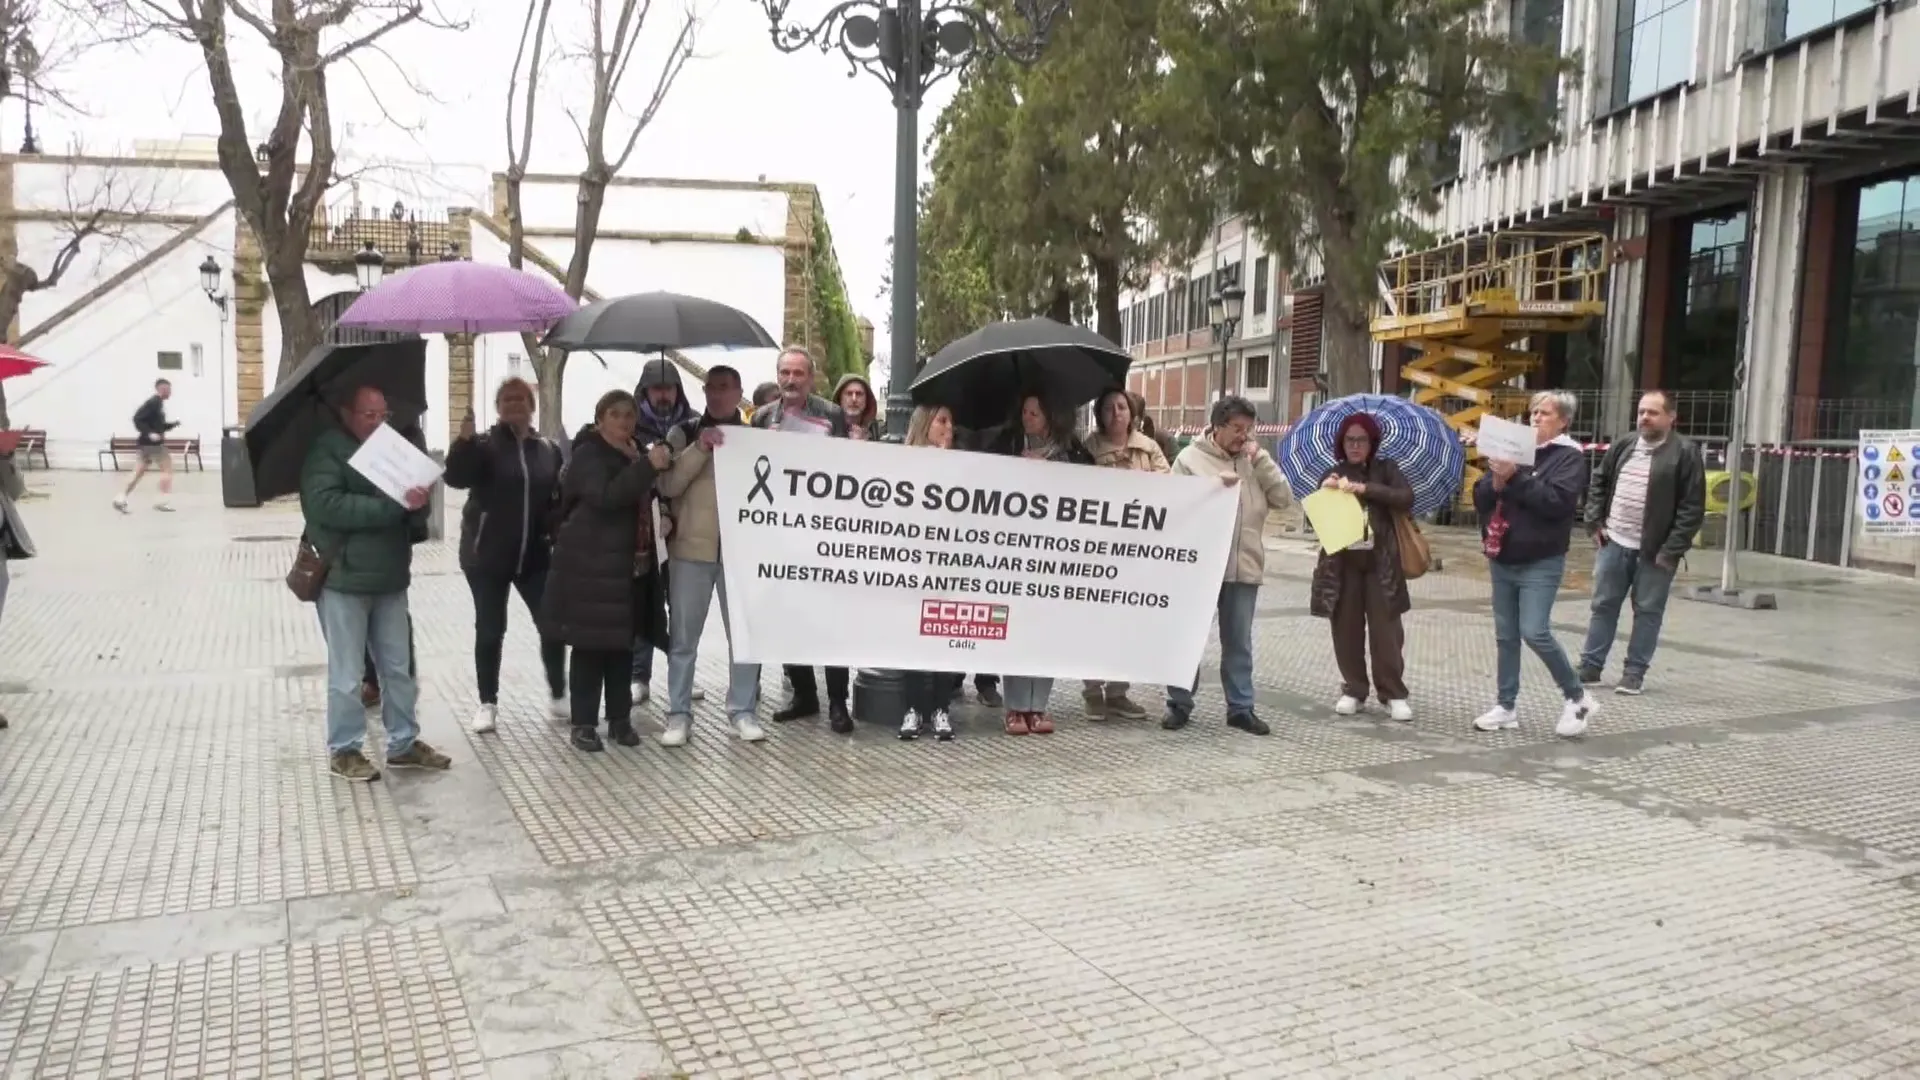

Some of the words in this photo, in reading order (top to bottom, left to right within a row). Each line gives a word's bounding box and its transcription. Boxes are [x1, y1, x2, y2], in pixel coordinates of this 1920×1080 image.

[783, 468, 915, 508] TOD@S
[921, 483, 1049, 520] SOMOS
[1055, 497, 1168, 531] BELÉN
[738, 508, 778, 526] POR
[782, 512, 807, 529] LA
[810, 514, 921, 539] SEGURIDAD
[924, 525, 950, 542] EN
[953, 527, 990, 545] LOS
[993, 530, 1081, 553] CENTROS
[1084, 540, 1107, 555] DE
[1112, 542, 1198, 564] MENORES
[816, 541, 922, 564] QUEREMOS
[926, 550, 1023, 572] TRABAJAR
[1025, 558, 1057, 574] SIN
[1059, 561, 1119, 580] MIEDO
[757, 563, 859, 585] NUESTRAS
[862, 571, 919, 589] VIDAS
[921, 575, 982, 593] ANTES
[985, 579, 1023, 596] QUE
[1025, 582, 1060, 599] SUS
[1063, 586, 1170, 609] BENEFICIOS
[922, 601, 990, 622] CCOO
[923, 620, 1004, 638] enseñanza
[948, 638, 976, 650] Cádiz
